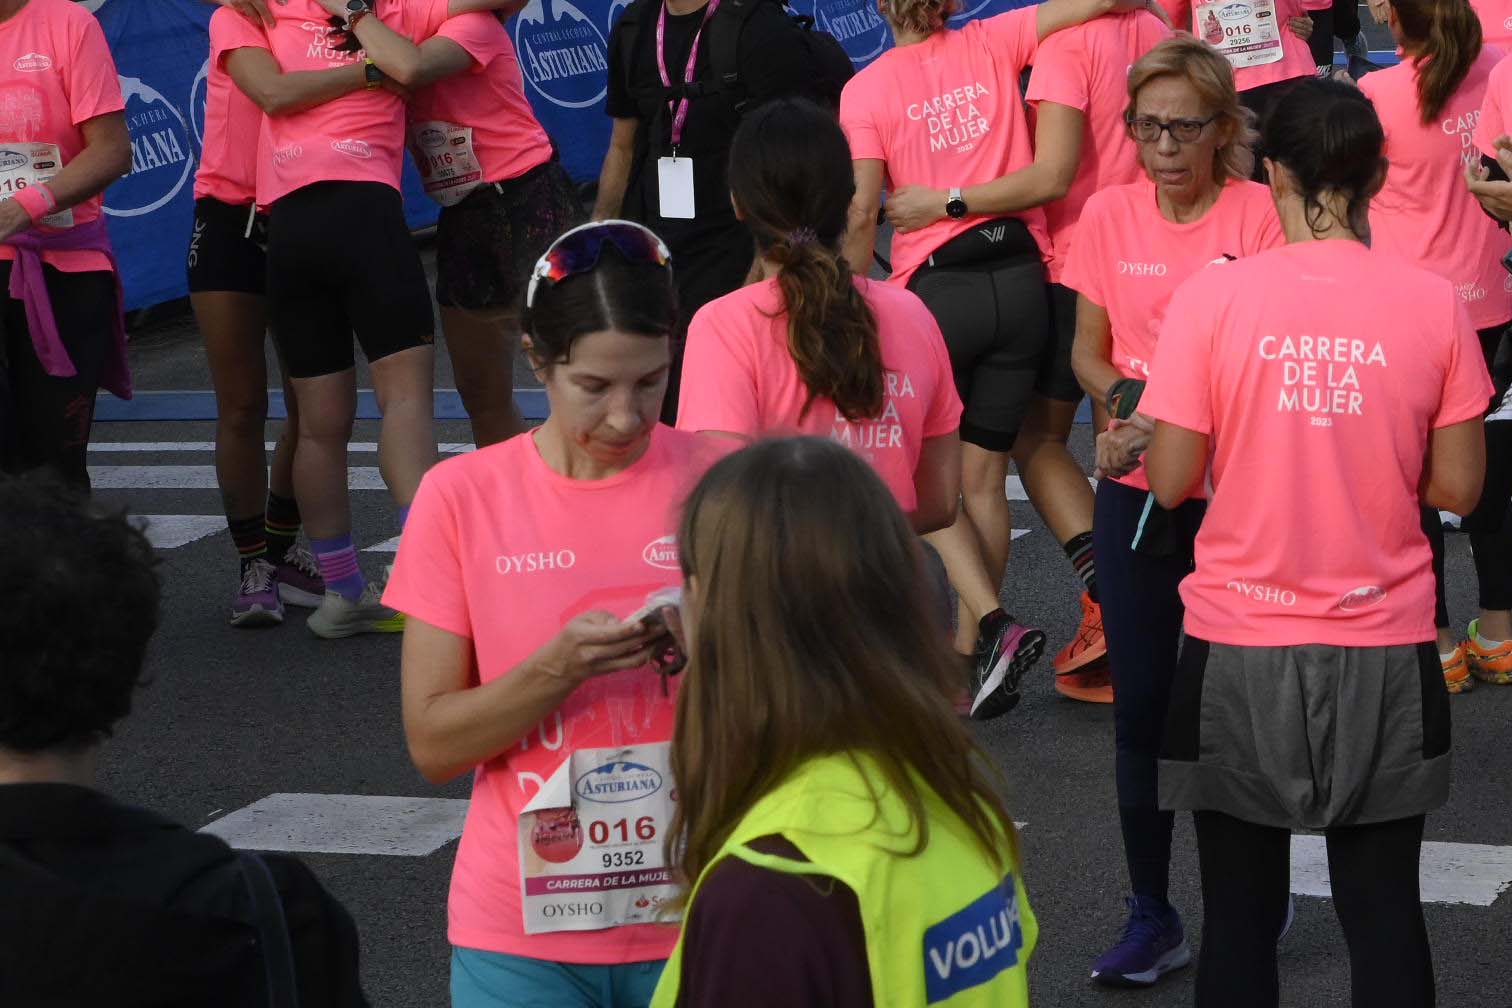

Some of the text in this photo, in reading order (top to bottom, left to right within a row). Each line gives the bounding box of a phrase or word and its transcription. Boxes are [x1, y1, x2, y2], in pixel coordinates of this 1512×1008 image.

[1225, 23, 1252, 38] 016
[1229, 36, 1251, 46] 29256
[525, 37, 608, 84] ASTURIANA
[907, 81, 991, 122] CARRERA
[927, 102, 982, 135] DE LA
[929, 117, 991, 153] MUJER
[430, 152, 453, 169] 016
[0, 177, 27, 192] 16
[1118, 260, 1168, 277] OYSHO
[1258, 335, 1388, 369] CARRERA
[1283, 362, 1360, 389] DE LA
[1276, 387, 1364, 416] MUJER
[1310, 415, 1333, 428] 2023
[496, 548, 576, 575] OYSHO
[521, 711, 564, 751] U
[582, 779, 658, 796] ASTURIANA
[588, 815, 657, 845] 016
[602, 849, 645, 869] 9352
[546, 871, 670, 890] CARRERA DE LA MUJE
[543, 901, 603, 919] OYSHO
[928, 894, 1020, 980] VOLU
